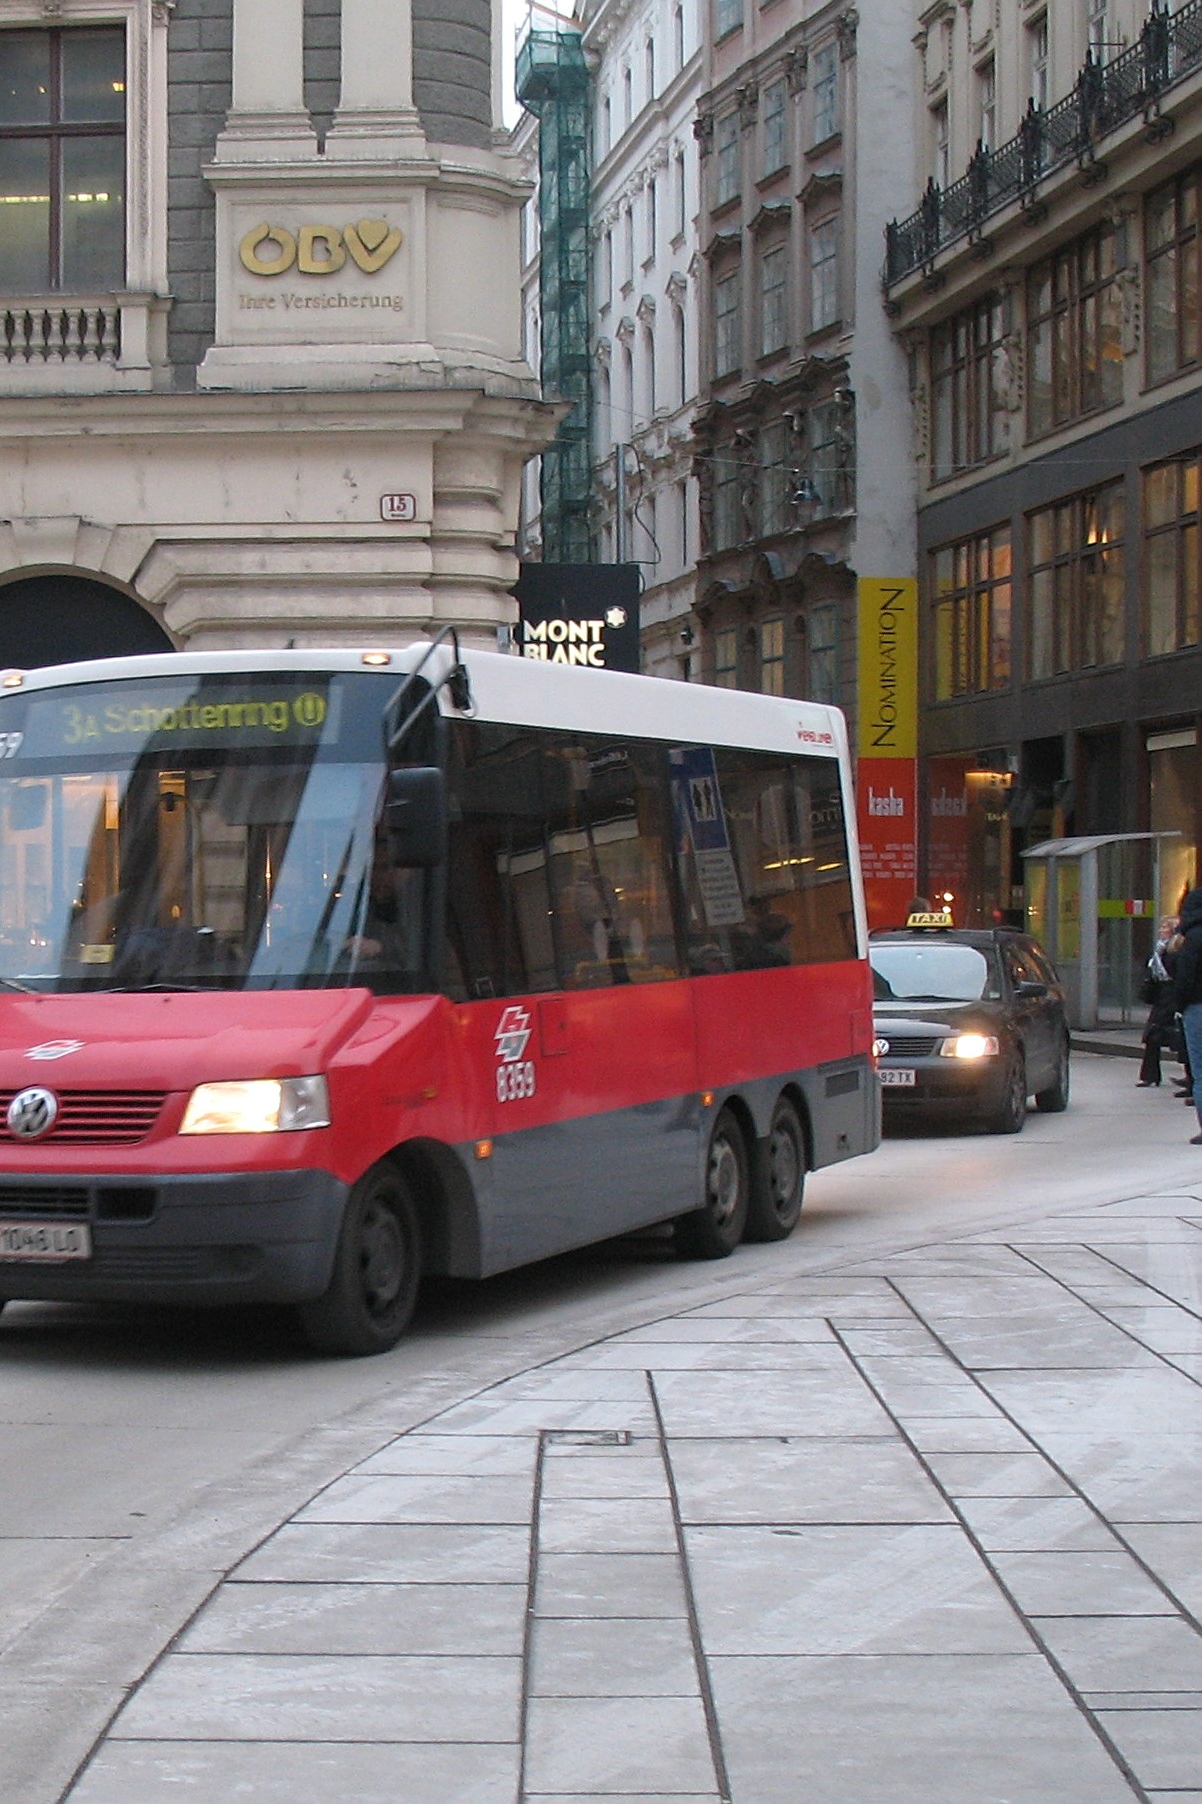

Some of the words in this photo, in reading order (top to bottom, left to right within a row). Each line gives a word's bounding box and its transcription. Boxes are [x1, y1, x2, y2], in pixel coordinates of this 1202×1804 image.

[239, 293, 276, 310] Ihre
[282, 293, 403, 311] Versicherung
[388, 495, 407, 512] 15
[523, 619, 605, 643] MONT
[523, 643, 605, 667] BLANC
[871, 588, 905, 747] NOMINATION
[103, 700, 289, 733] Schottenring
[869, 786, 904, 816] kasha
[911, 914, 948, 924] TAXI
[497, 1060, 535, 1103] 8359
